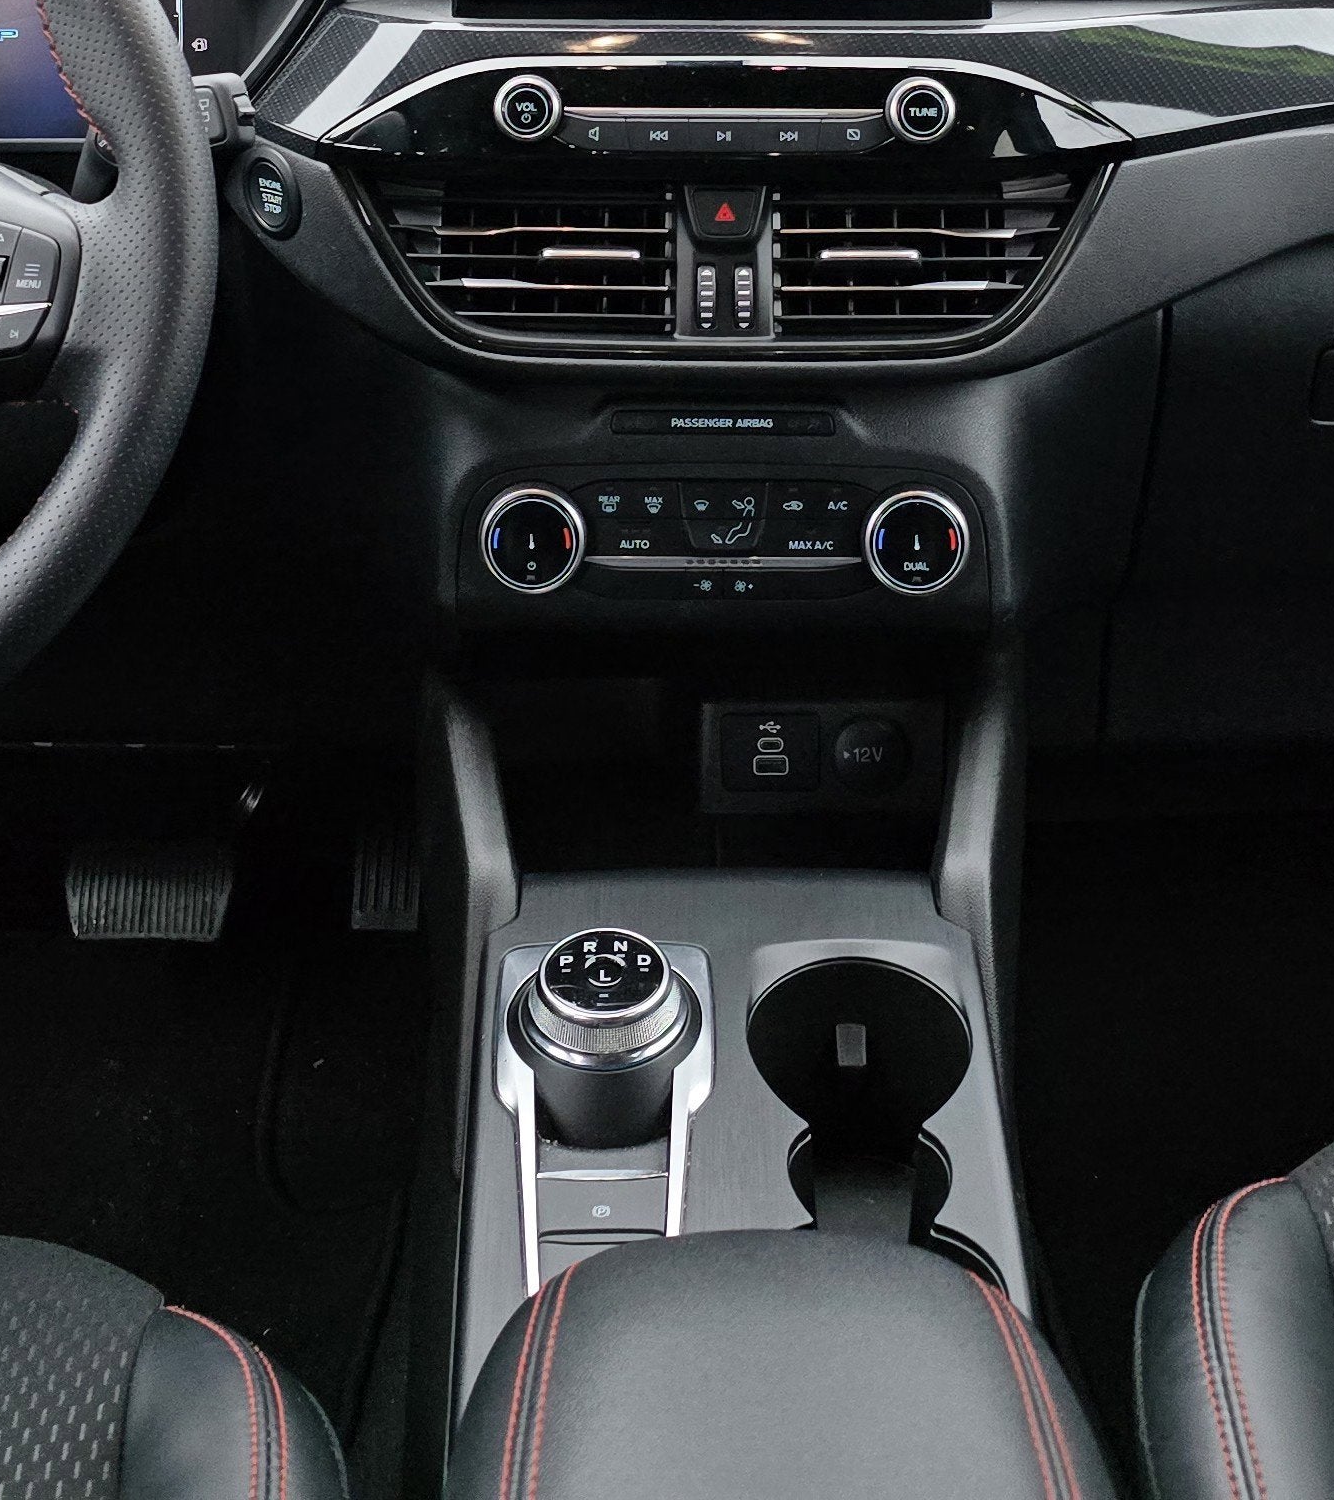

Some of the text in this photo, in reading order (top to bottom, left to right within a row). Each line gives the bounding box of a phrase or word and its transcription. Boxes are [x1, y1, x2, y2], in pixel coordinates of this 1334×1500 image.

[514, 101, 537, 113] VOL
[908, 106, 938, 119] TUNE
[262, 193, 282, 204] START
[264, 204, 281, 214] STOP
[15, 278, 42, 289] MENU
[671, 417, 732, 429] PASSENGER
[735, 417, 774, 429] AIRBAG
[598, 495, 620, 504] REAR
[644, 496, 663, 505] MAX
[827, 500, 849, 512] A/C
[619, 539, 650, 550] AUTO
[788, 539, 835, 552] MAX A/C
[903, 561, 930, 572] DUAL
[852, 745, 884, 764] 12V
[559, 940, 651, 967] P R N D
[599, 970, 611, 982] L
